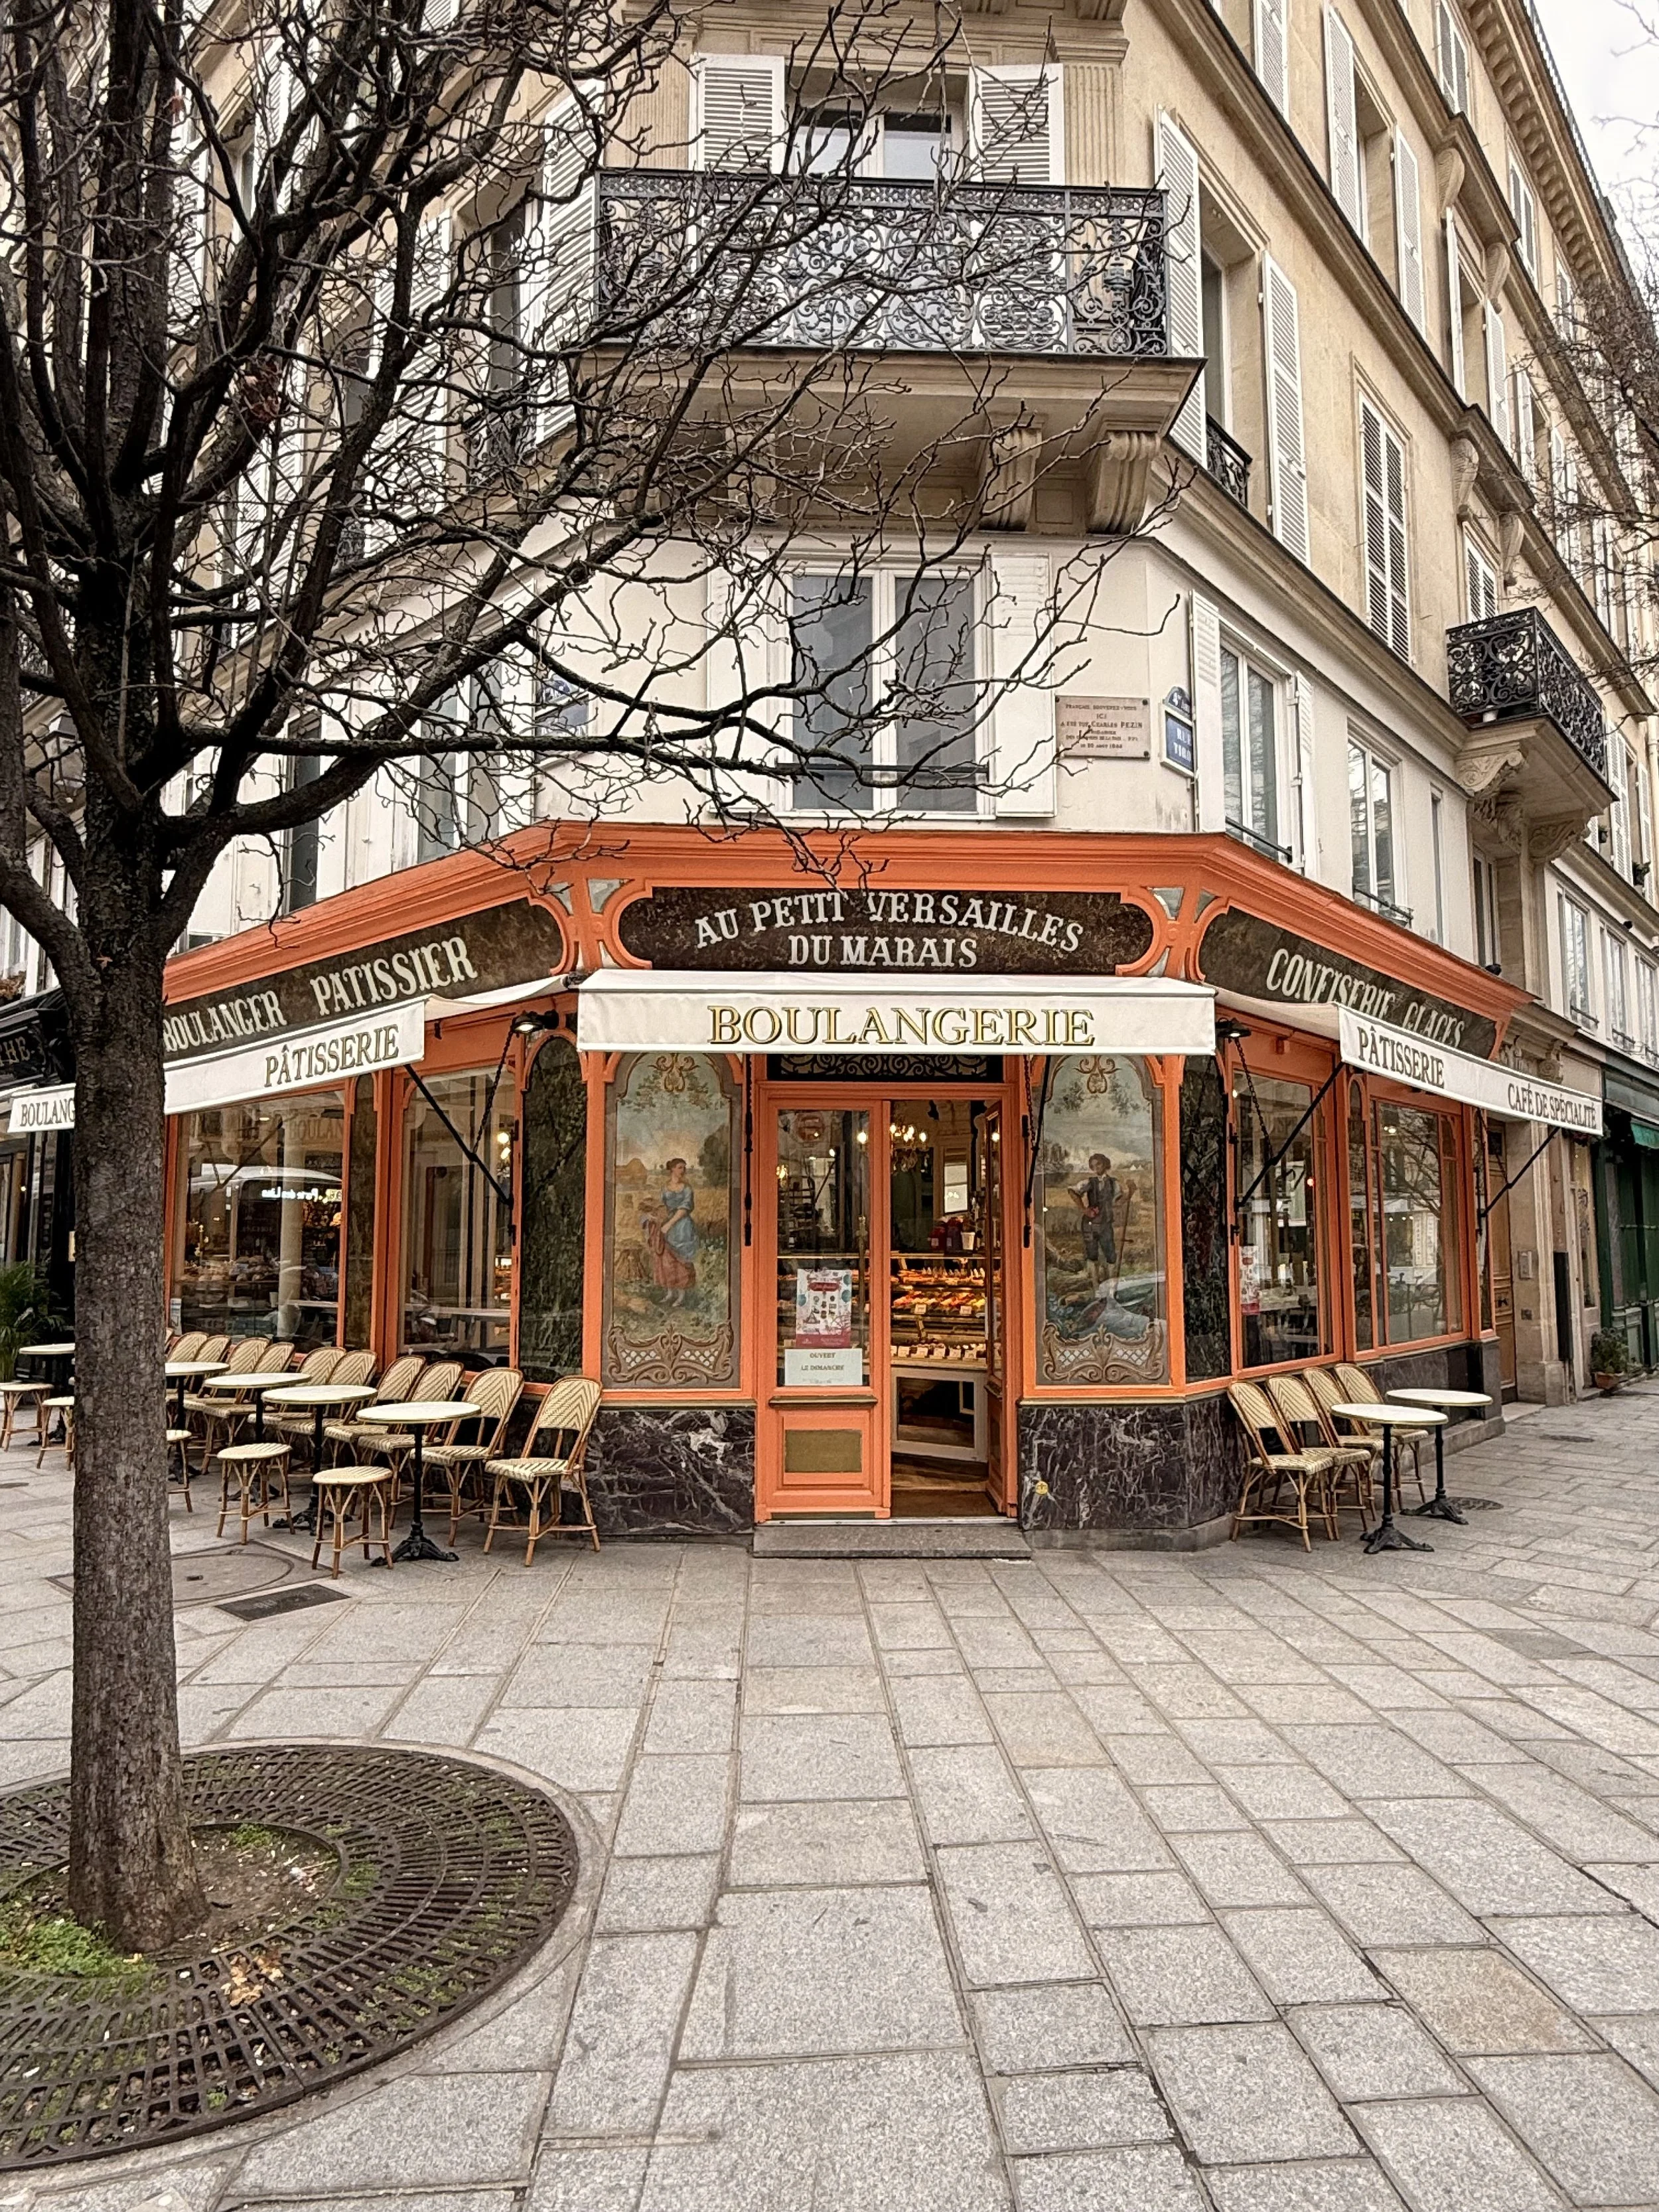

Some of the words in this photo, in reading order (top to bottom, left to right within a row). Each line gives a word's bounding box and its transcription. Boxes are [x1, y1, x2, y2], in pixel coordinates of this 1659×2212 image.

[695, 909, 739, 948] AU
[749, 891, 845, 932] PETIT
[863, 891, 1084, 952] VERSAILLES
[788, 934, 833, 965] DU
[840, 935, 977, 968] MARAIS
[163, 990, 287, 1053] BOULANGER
[310, 936, 478, 1016] PATISSIER
[1266, 948, 1396, 1019] CONFISERIE
[264, 1024, 399, 1088] PÂTISSERIE
[707, 1005, 1094, 1046] BOULANGERIE
[1357, 1025, 1445, 1095] PÂTISSERIE
[1508, 1082, 1534, 1115] CAFÉ
[1535, 1092, 1549, 1118] DE
[1550, 1093, 1596, 1128] SPÉCIALITÉ
